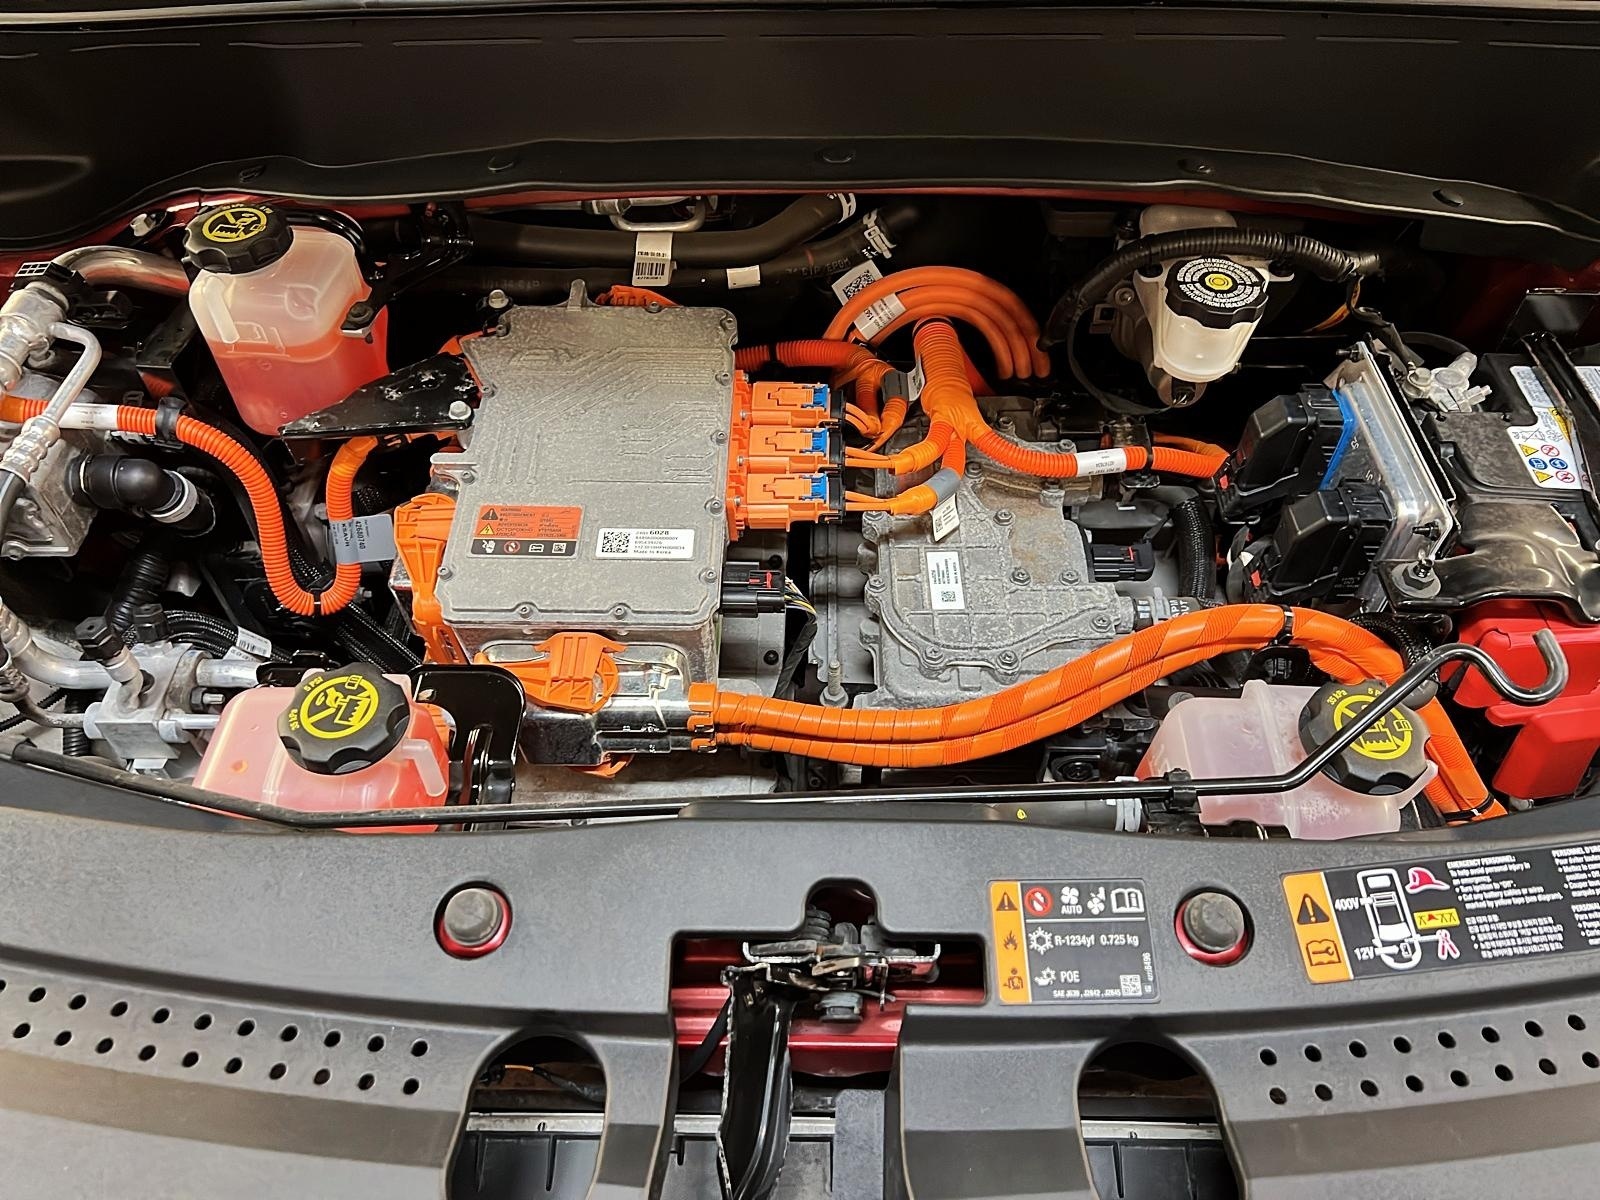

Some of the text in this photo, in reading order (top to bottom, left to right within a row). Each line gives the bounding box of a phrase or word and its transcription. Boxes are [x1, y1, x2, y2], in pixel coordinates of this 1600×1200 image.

[1061, 905, 1083, 915] AUTO
[1334, 897, 1360, 911] 400V
[1054, 935, 1139, 948] R-1234yf 0.725 kg
[1353, 946, 1374, 961] 12V
[1060, 970, 1080, 983] POE
